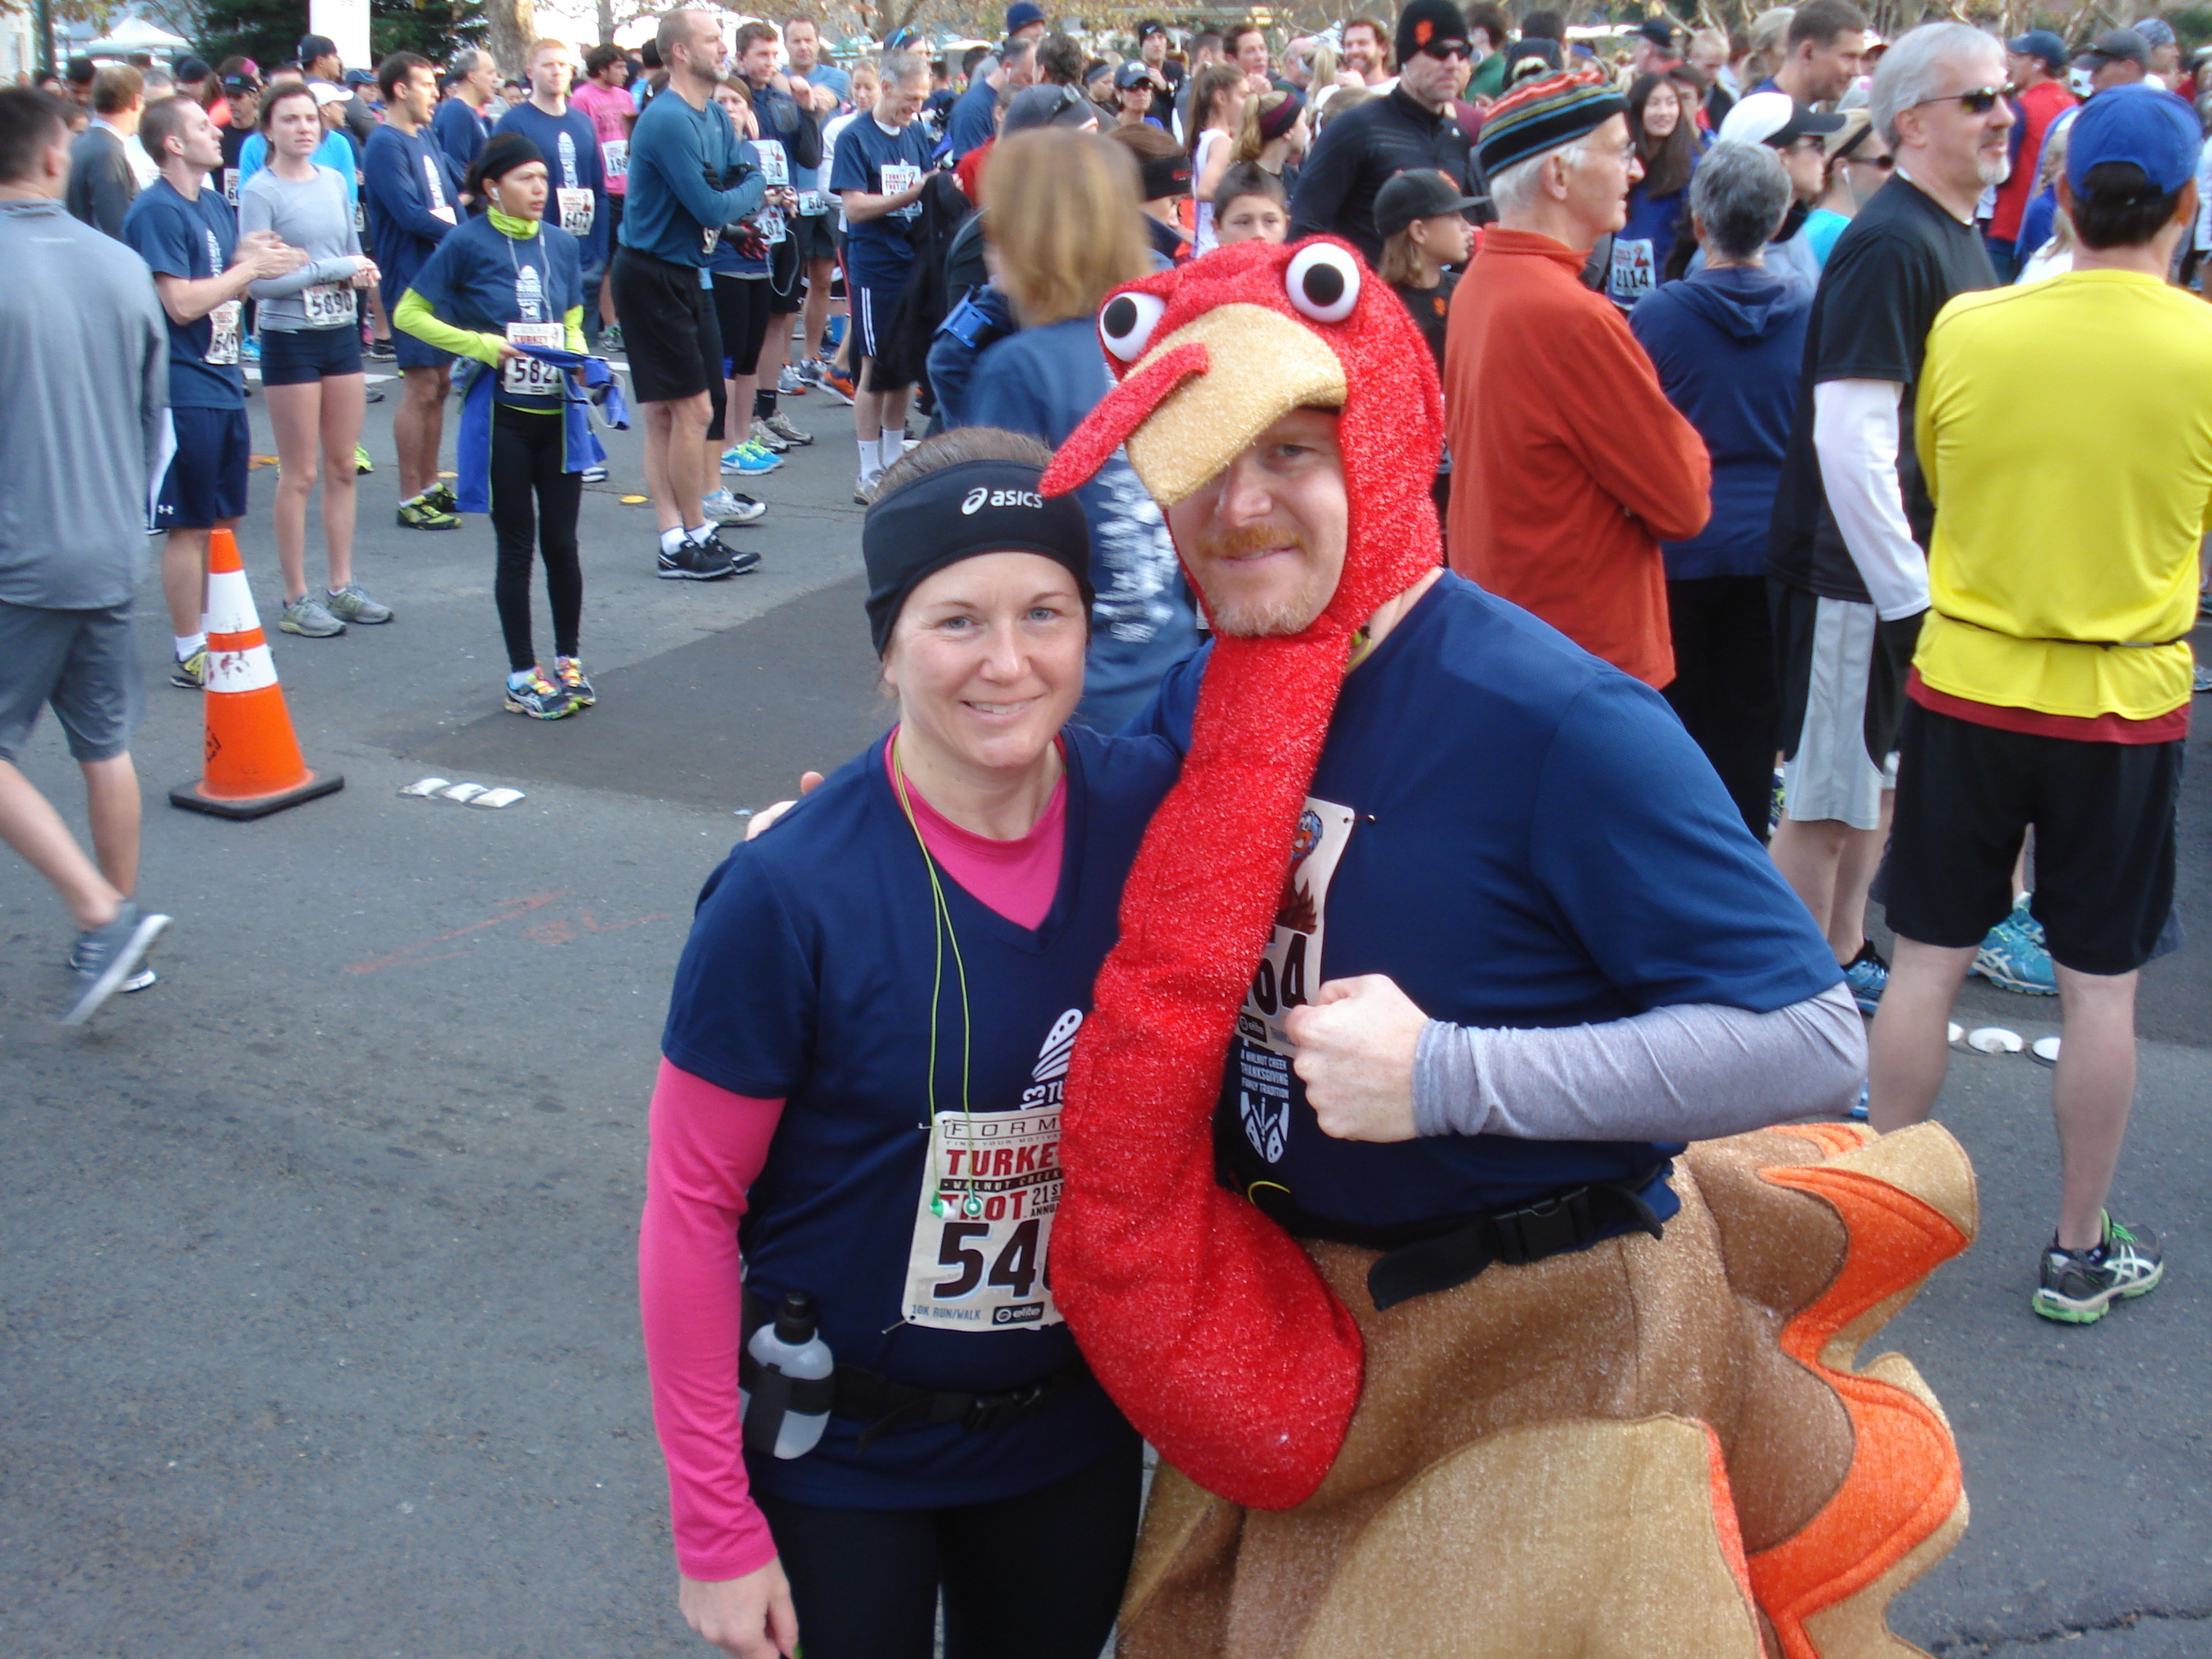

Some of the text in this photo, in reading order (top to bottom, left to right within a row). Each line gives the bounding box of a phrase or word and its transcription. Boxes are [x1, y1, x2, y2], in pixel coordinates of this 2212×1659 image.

[1615, 267, 1649, 288] 2114
[990, 489, 1043, 509] asics
[1240, 1062, 1289, 1086] THANKSGIVING
[1268, 1057, 1288, 1071] CREEK
[1259, 1082, 1289, 1099] TRADITION
[952, 1170, 1060, 1190] WALNUT CREEK
[933, 1219, 1054, 1299] 54
[911, 1304, 930, 1315] 10K
[933, 1307, 981, 1320] RUN/WALK
